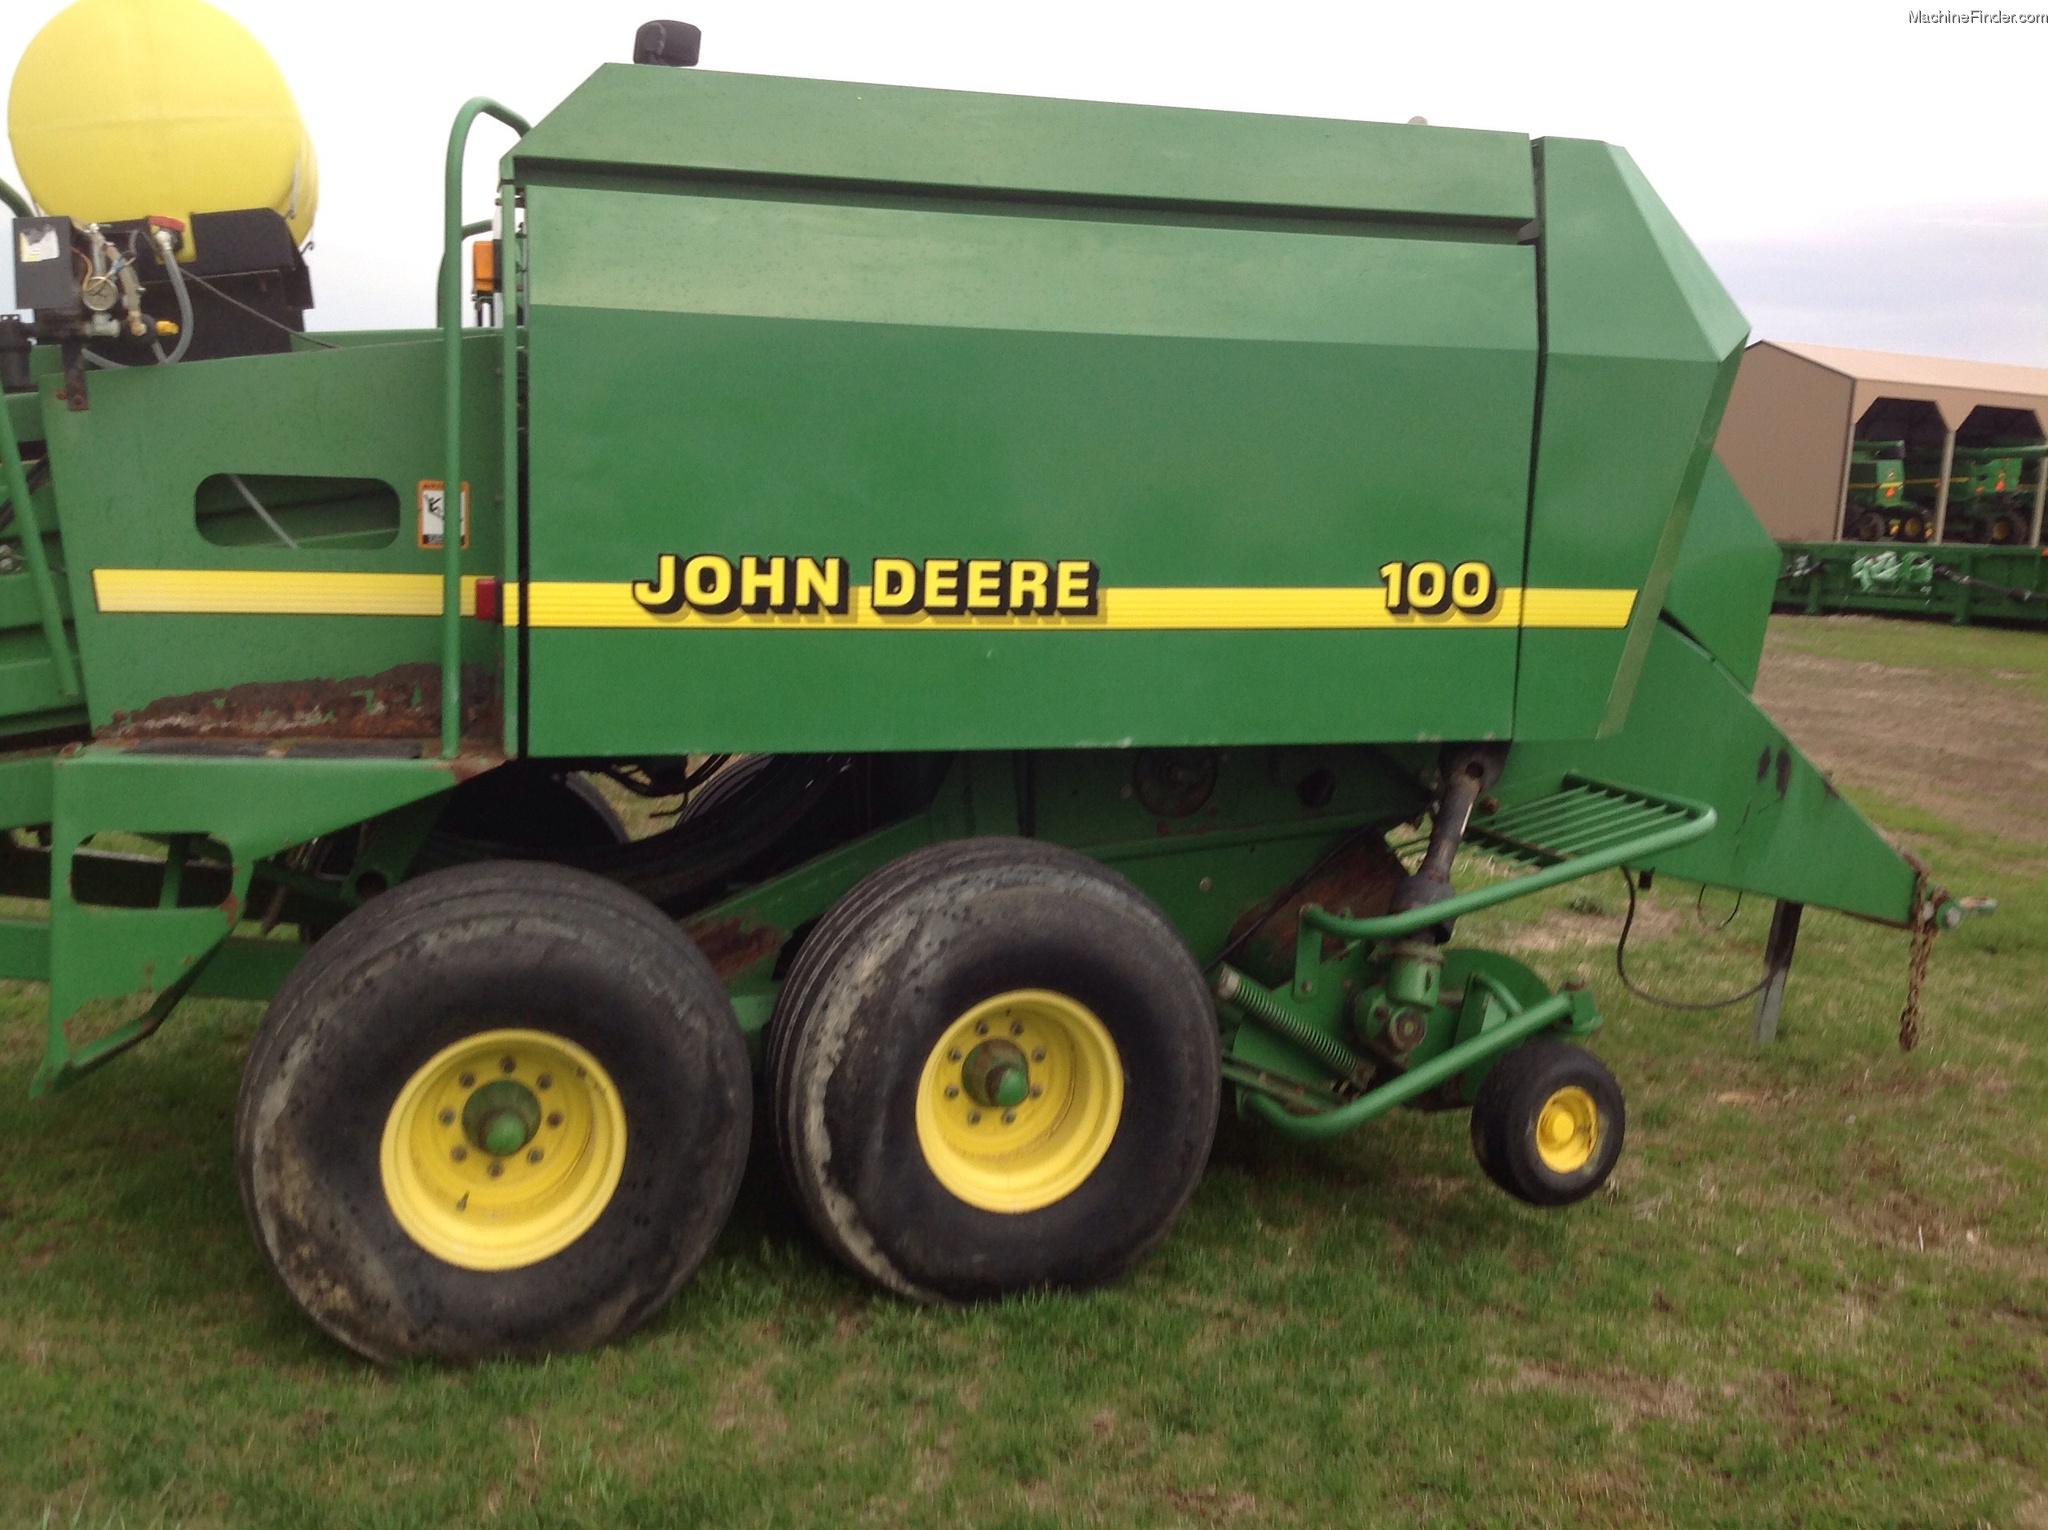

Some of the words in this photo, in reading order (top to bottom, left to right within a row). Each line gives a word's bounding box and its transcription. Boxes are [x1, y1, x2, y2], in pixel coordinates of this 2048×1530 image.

[632, 553, 849, 614] JOHN
[871, 557, 1100, 616] DEERE
[1379, 559, 1497, 615] 100
